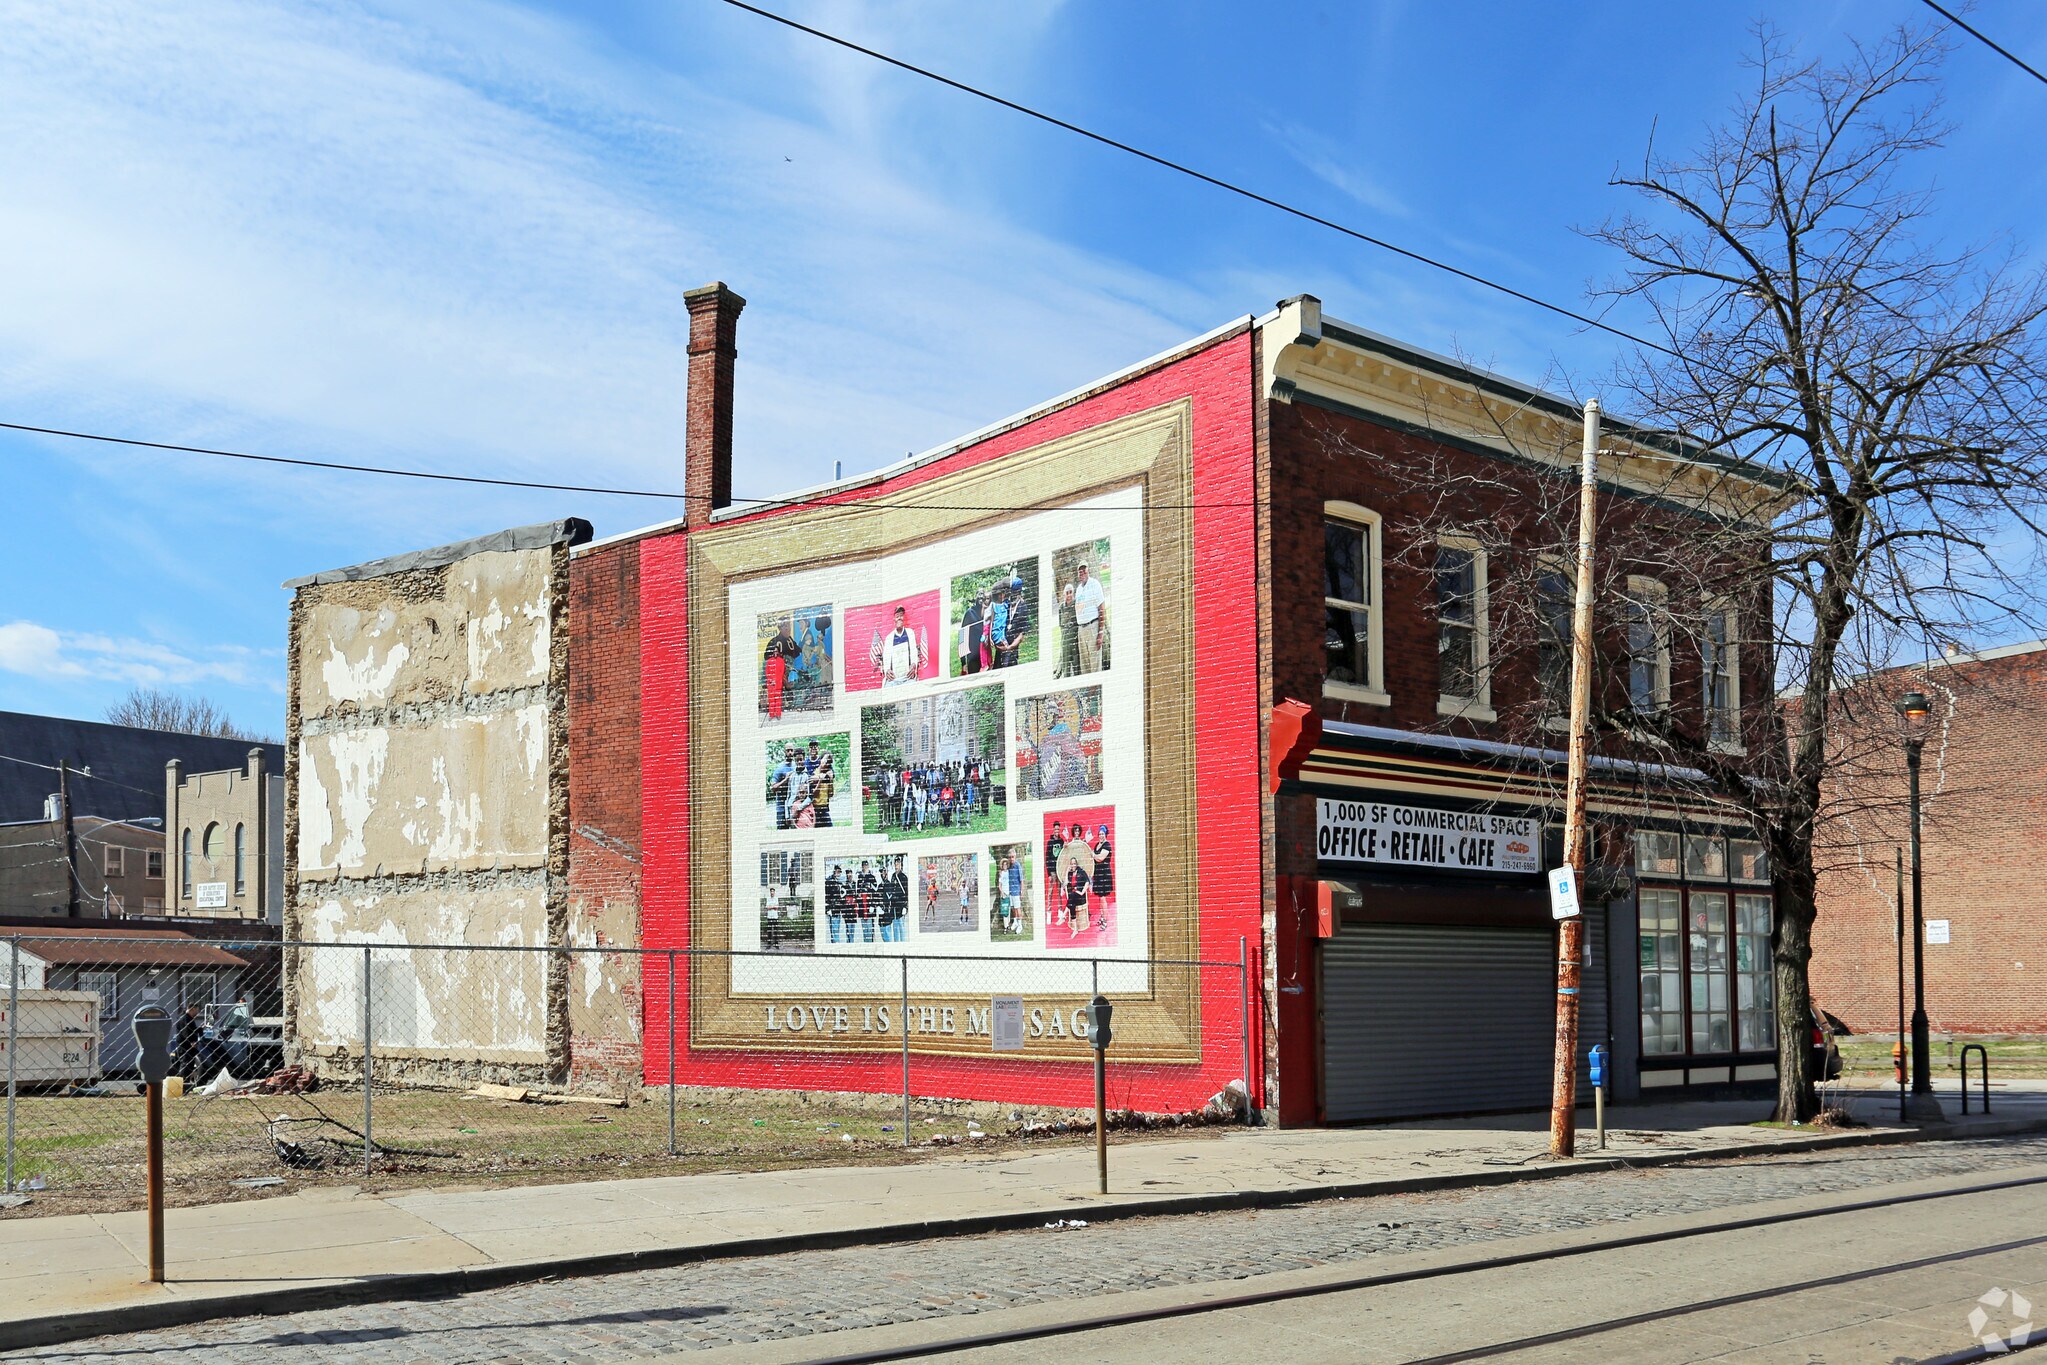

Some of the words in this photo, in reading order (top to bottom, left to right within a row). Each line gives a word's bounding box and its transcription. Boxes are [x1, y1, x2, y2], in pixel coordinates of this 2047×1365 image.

[1324, 802, 1365, 823] 1,000
[1372, 805, 1387, 823] SF
[1393, 808, 1486, 833] COMMERCIAL
[1491, 817, 1530, 837] SPACE
[1319, 825, 1377, 858] OFFICE
[1391, 830, 1445, 863] RETAIL
[1458, 836, 1494, 867] CAFE
[1501, 861, 1536, 871] 215-247-6960
[765, 1005, 849, 1031] LOVE
[862, 1005, 890, 1032] IS
[902, 1006, 955, 1034] THE
[966, 1007, 1091, 1040] MSAG
